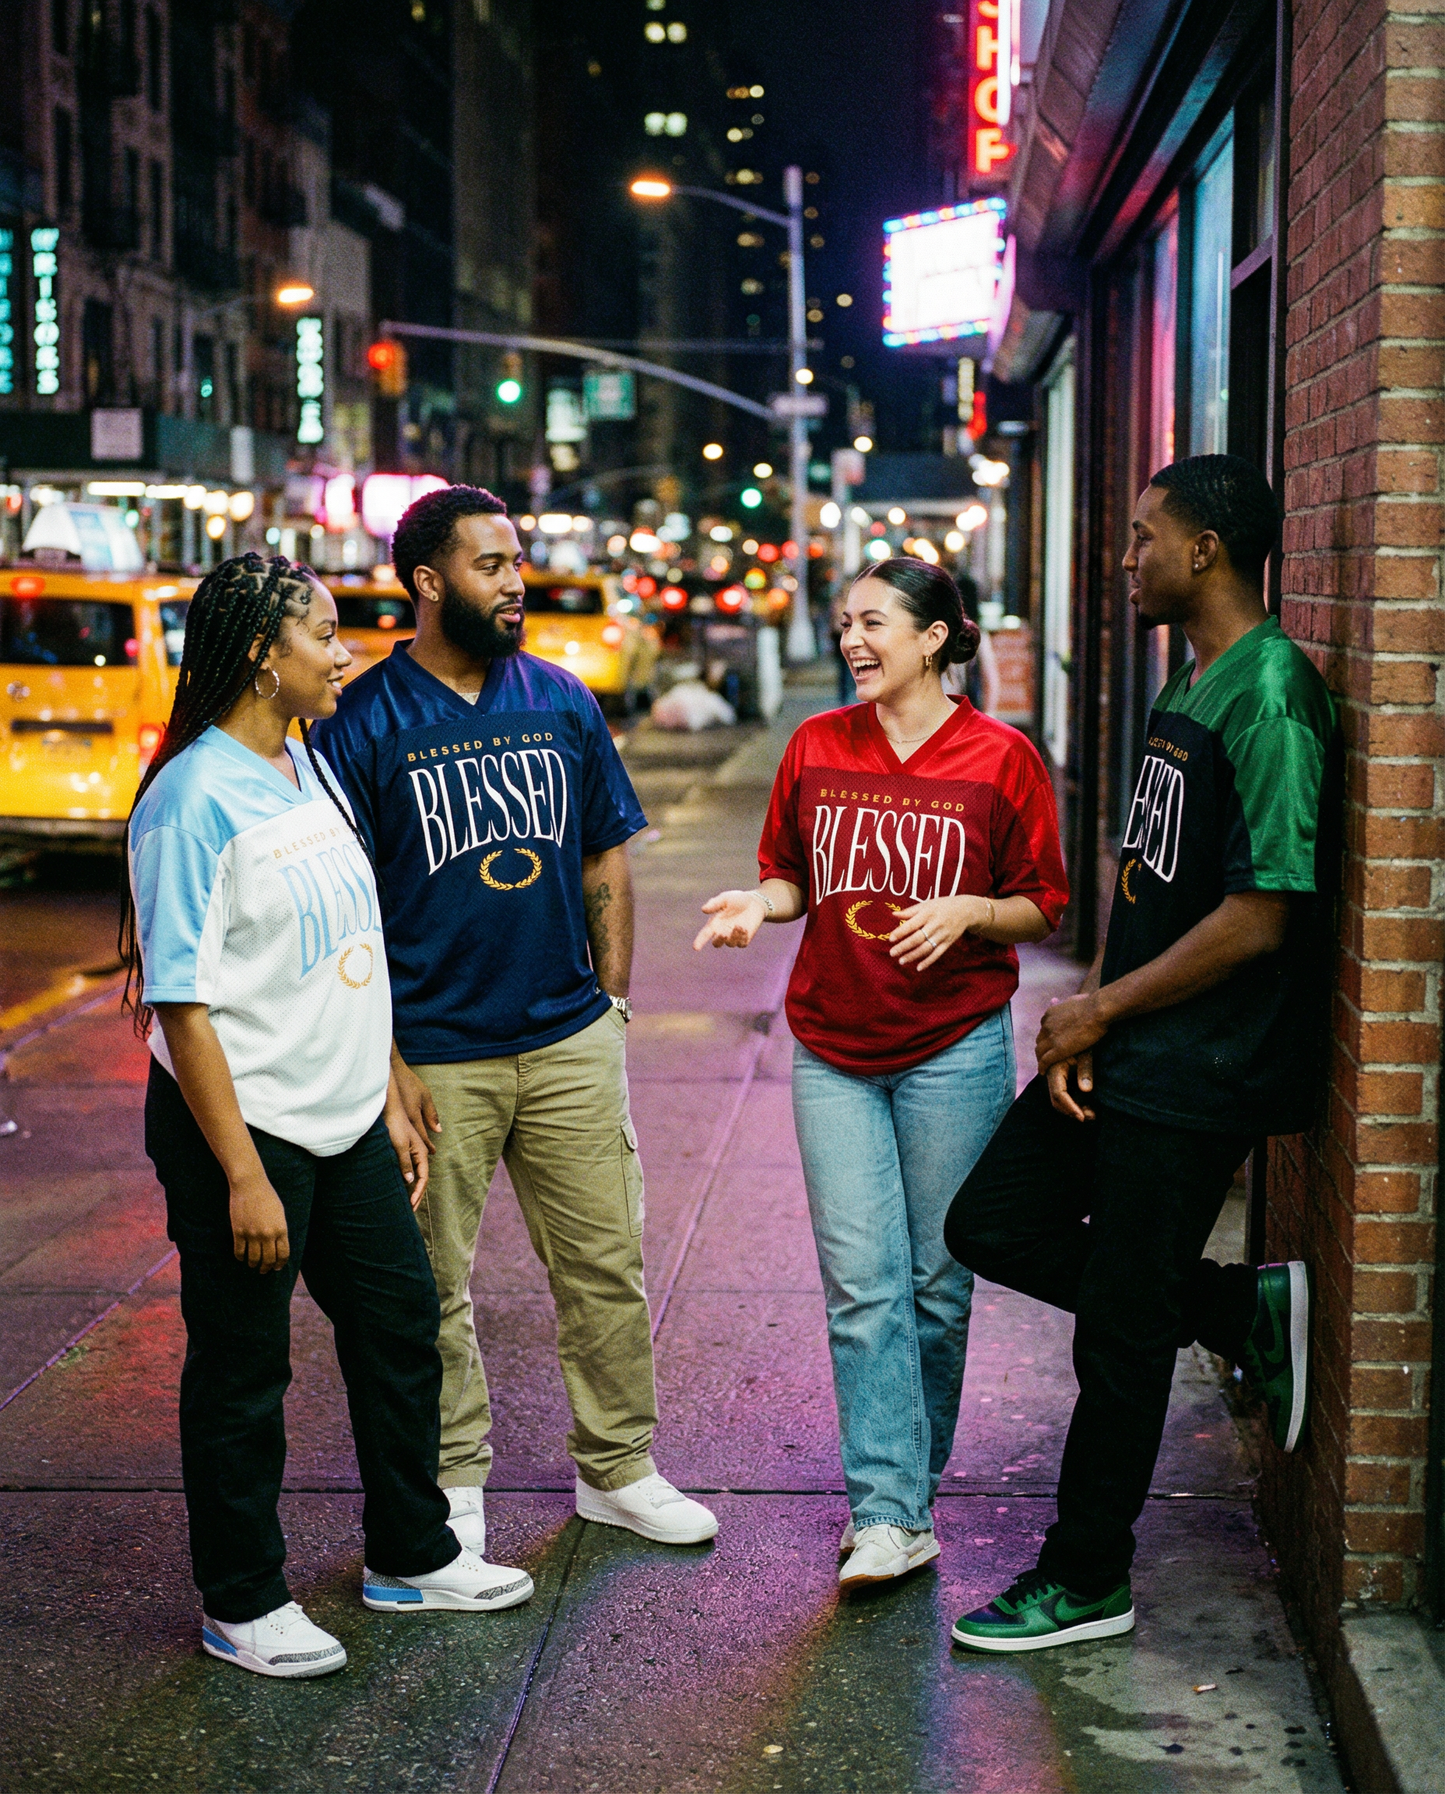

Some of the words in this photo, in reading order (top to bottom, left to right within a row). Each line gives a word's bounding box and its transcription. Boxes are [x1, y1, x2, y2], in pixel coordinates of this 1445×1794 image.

[407, 740, 483, 762] BLESSED
[492, 736, 511, 746] BY
[521, 732, 554, 743] GOD
[408, 749, 567, 875] BLESSED
[820, 788, 892, 804] BLESSED
[902, 798, 921, 807] BY
[931, 800, 965, 812] GOD
[273, 831, 326, 859] BLESSED
[813, 805, 965, 906] BLESSED
